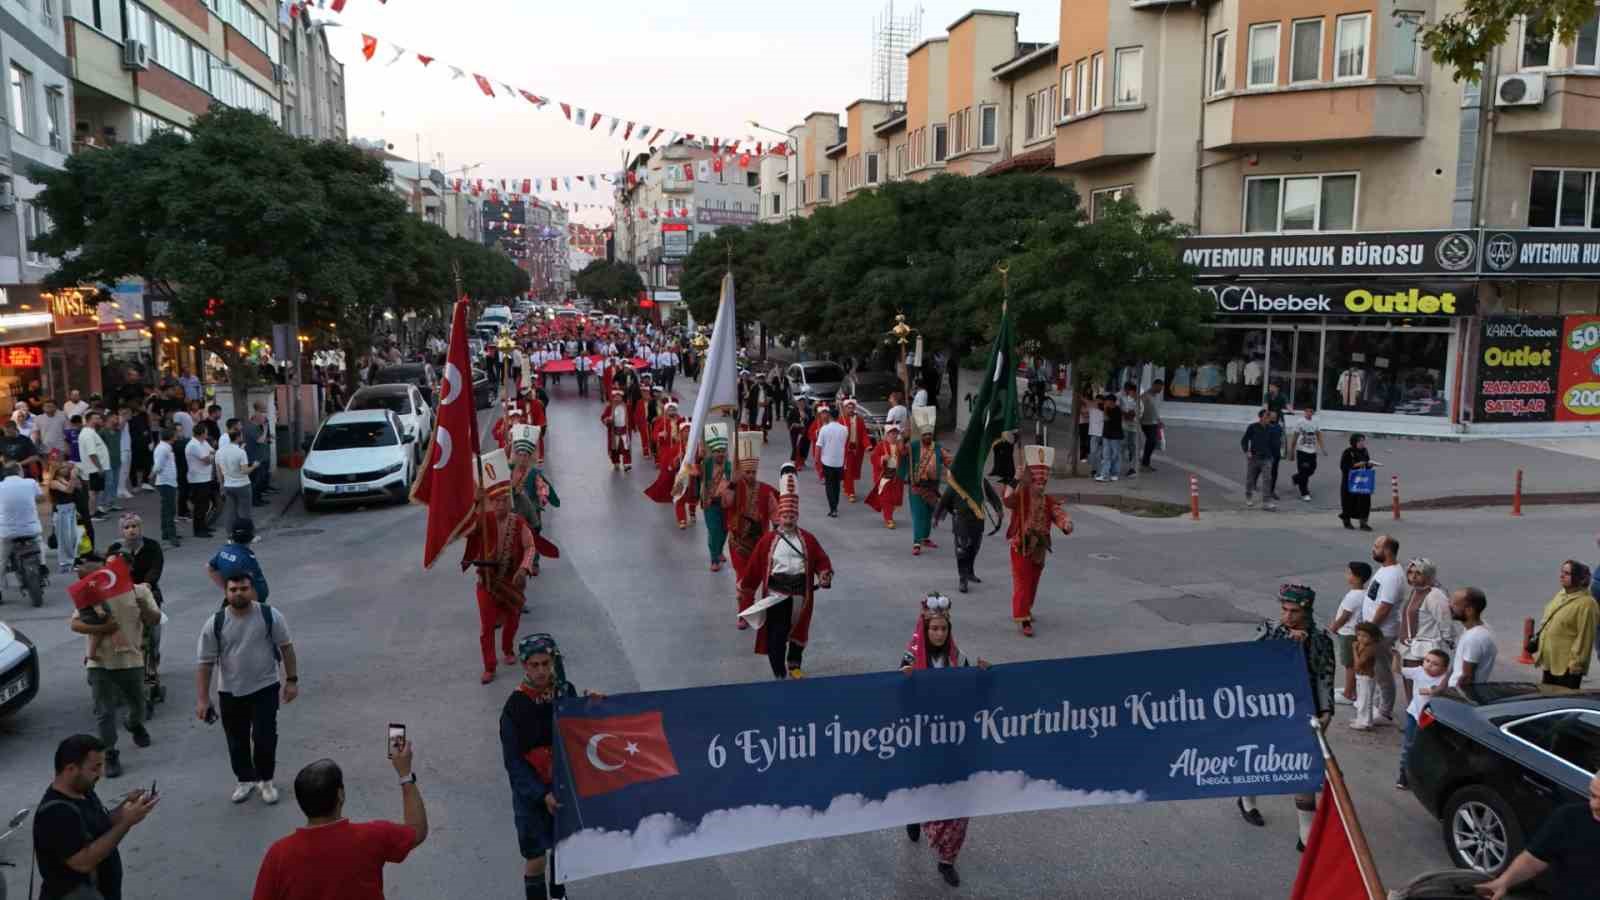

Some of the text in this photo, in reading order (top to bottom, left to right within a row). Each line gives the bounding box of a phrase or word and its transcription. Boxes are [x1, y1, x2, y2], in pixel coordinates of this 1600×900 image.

[1183, 241, 1425, 268] AYTEMUR HUKUK BÜROSU
[1519, 242, 1580, 264] AYTEMUR
[1344, 288, 1457, 314] Outlet
[1484, 345, 1552, 367] Outlet
[1482, 380, 1551, 395] ZARARINA
[1484, 398, 1546, 416] SATIŞLAR
[707, 684, 1295, 773] 6 Eylül İnegöl'ün Kurtuluşu Kutlu Olsun
[1168, 743, 1312, 787] Alper Taban
